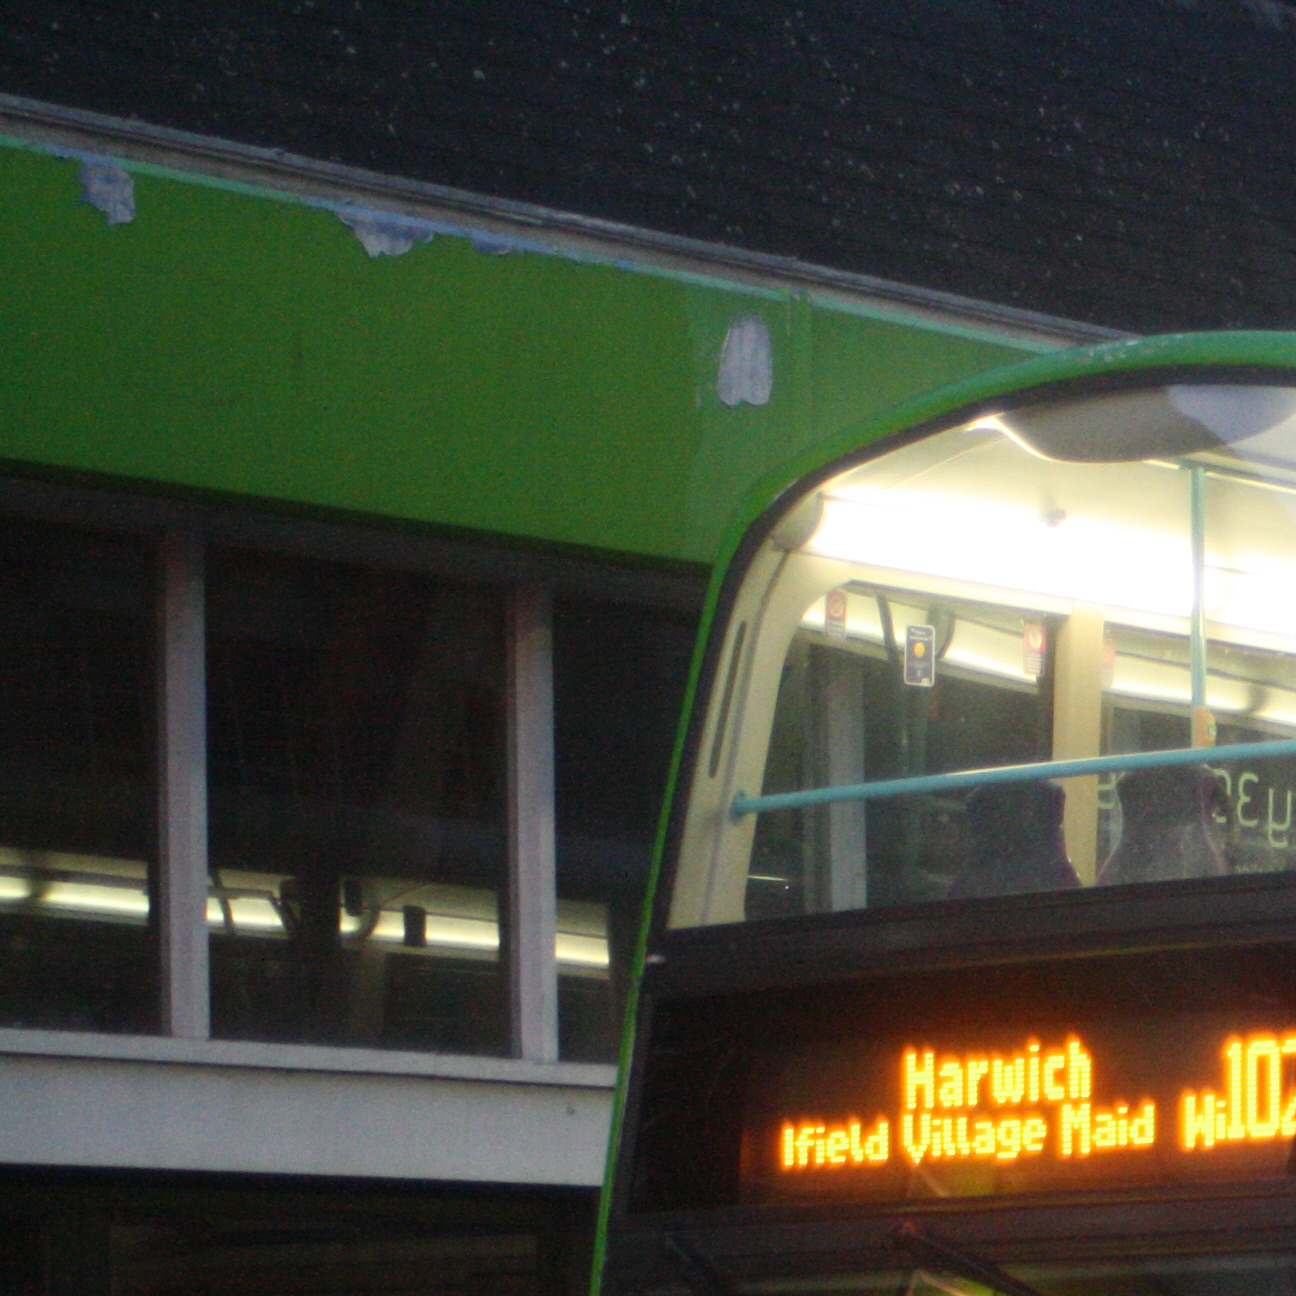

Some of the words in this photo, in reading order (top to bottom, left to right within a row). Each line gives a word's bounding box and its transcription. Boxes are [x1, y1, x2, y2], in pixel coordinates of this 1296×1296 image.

[904, 1035, 1092, 1109] Harwich
[902, 1113, 1048, 1164] Village
[1061, 1104, 1156, 1156] Maid
